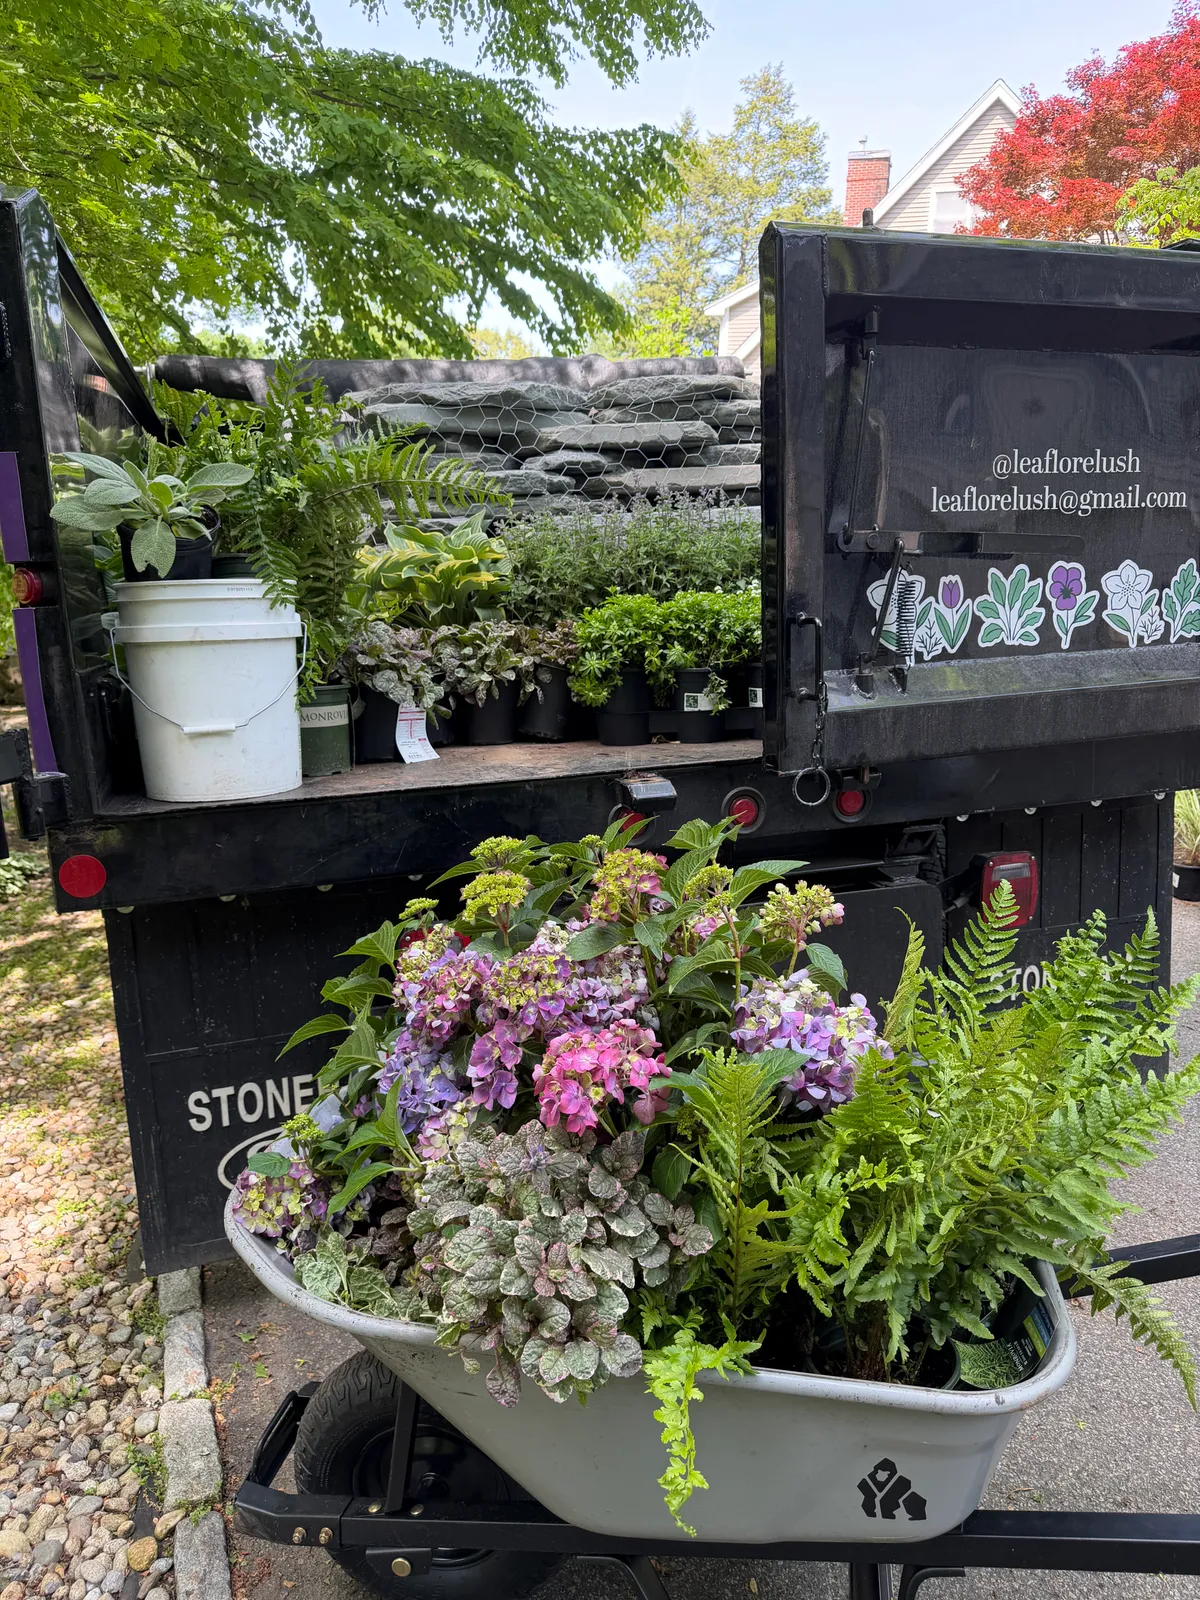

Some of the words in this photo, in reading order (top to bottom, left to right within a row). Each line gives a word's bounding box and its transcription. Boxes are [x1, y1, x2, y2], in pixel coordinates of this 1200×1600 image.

[992, 448, 1141, 479] @leaflorelush
[930, 484, 1188, 517] leaflorelush@gmail.com
[300, 710, 347, 722] MONROVI
